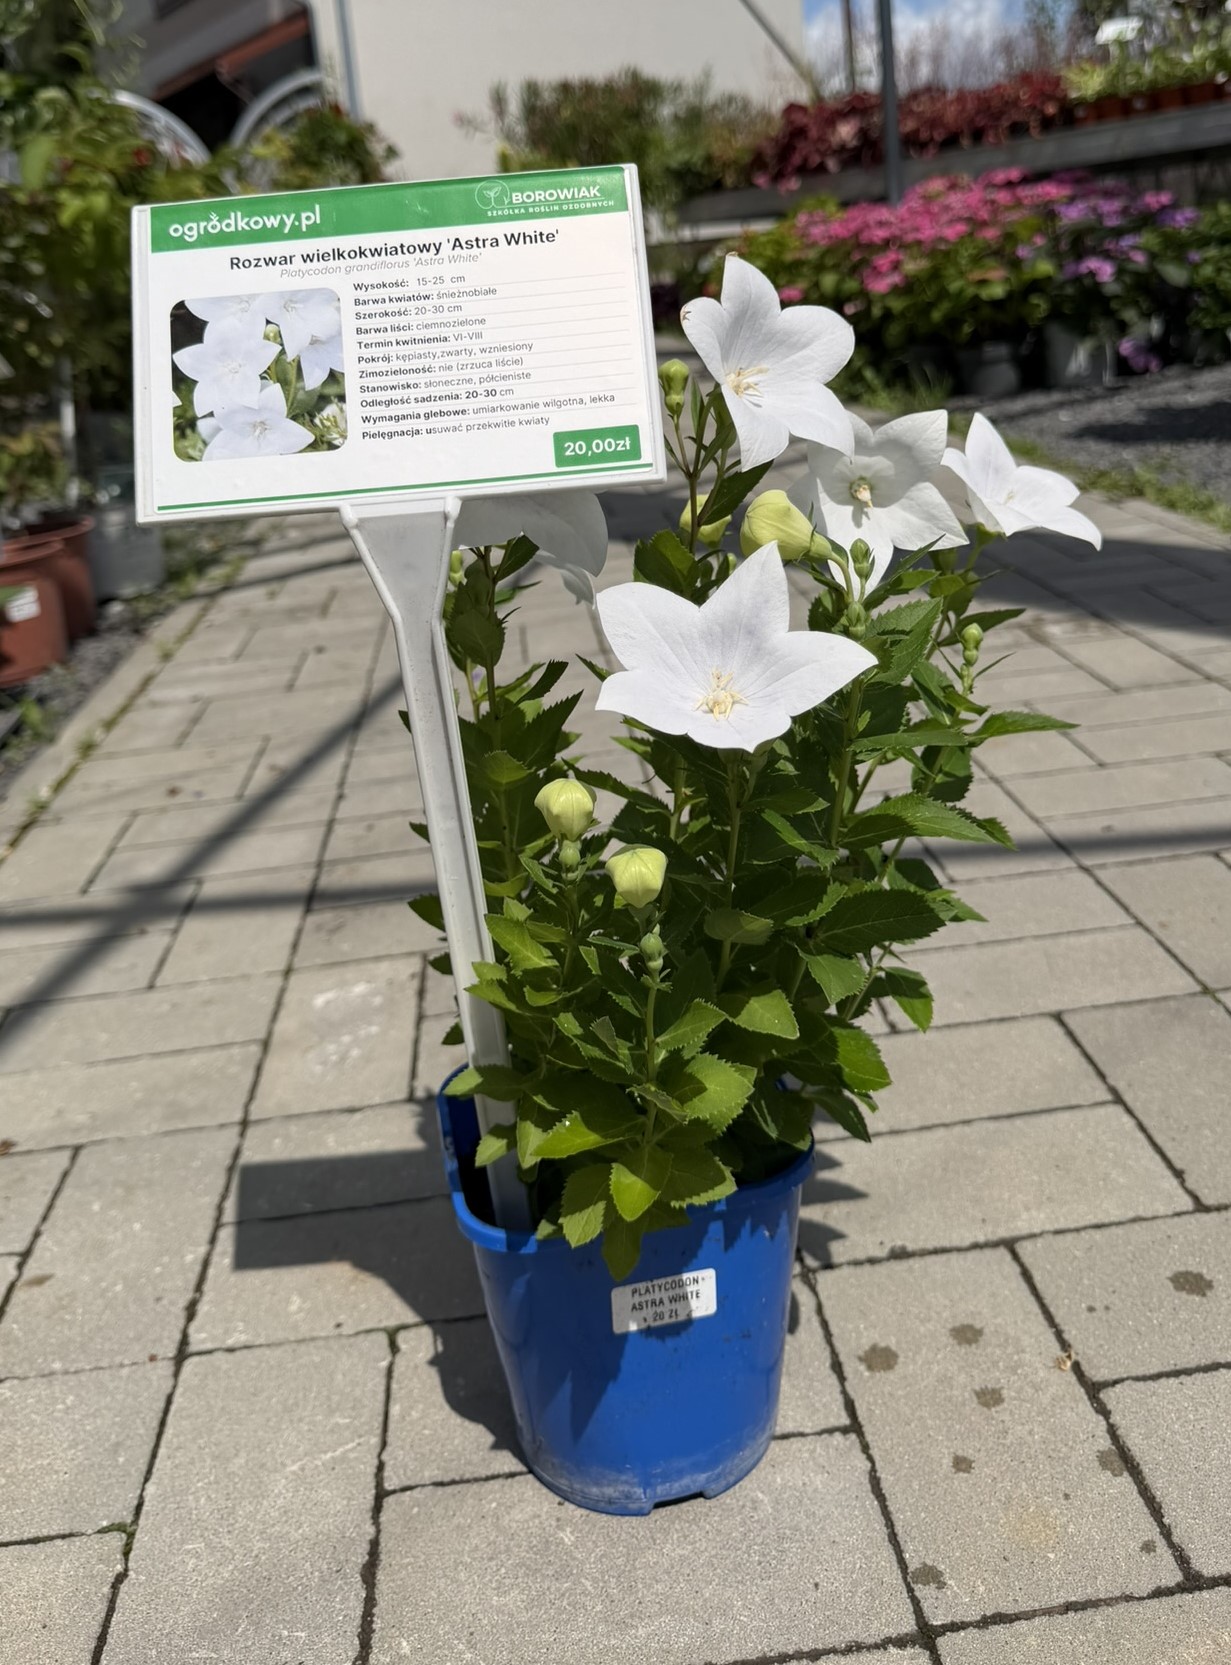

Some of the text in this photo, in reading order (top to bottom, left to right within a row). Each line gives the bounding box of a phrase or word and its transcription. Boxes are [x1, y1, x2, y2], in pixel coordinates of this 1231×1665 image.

[512, 186, 600, 204] BOROWIAK
[487, 200, 614, 216] SZKÓŁKA ROŚLIN OZDOBNYCH
[230, 230, 559, 270] Rozwar wielkokwiatowy 'Astra White'
[280, 252, 482, 279] Platycodon grandiflorus 'Astra White'
[353, 275, 466, 292] Wysokość: 15-25 cm
[354, 287, 497, 306] Barwa kwiatów: śnieżnobiałe
[355, 304, 462, 320] Szerokość: 20-30 cm
[356, 316, 486, 336] Barwa liści: ciemnozielone
[357, 331, 483, 350] Termin kwitnienia: VI-VIII
[358, 353, 394, 365] Pokrój:
[479, 342, 533, 355] wzniesiony
[359, 356, 524, 378] Zimozieloność: nie (zrzuca liście)
[360, 371, 531, 394] Stanowisko: słoneczne, półcieniste
[360, 388, 514, 409] Odległość sadzenia: 20-30 cm
[361, 394, 614, 425] Wymagania glebowe: umiarkowanie wilgotna, lekka
[362, 416, 550, 440] Pielęgnacja: usuwać przekwitłe kwiaty
[564, 436, 631, 456] 20,00zł
[631, 1289, 700, 1312] ASTRA WHITE
